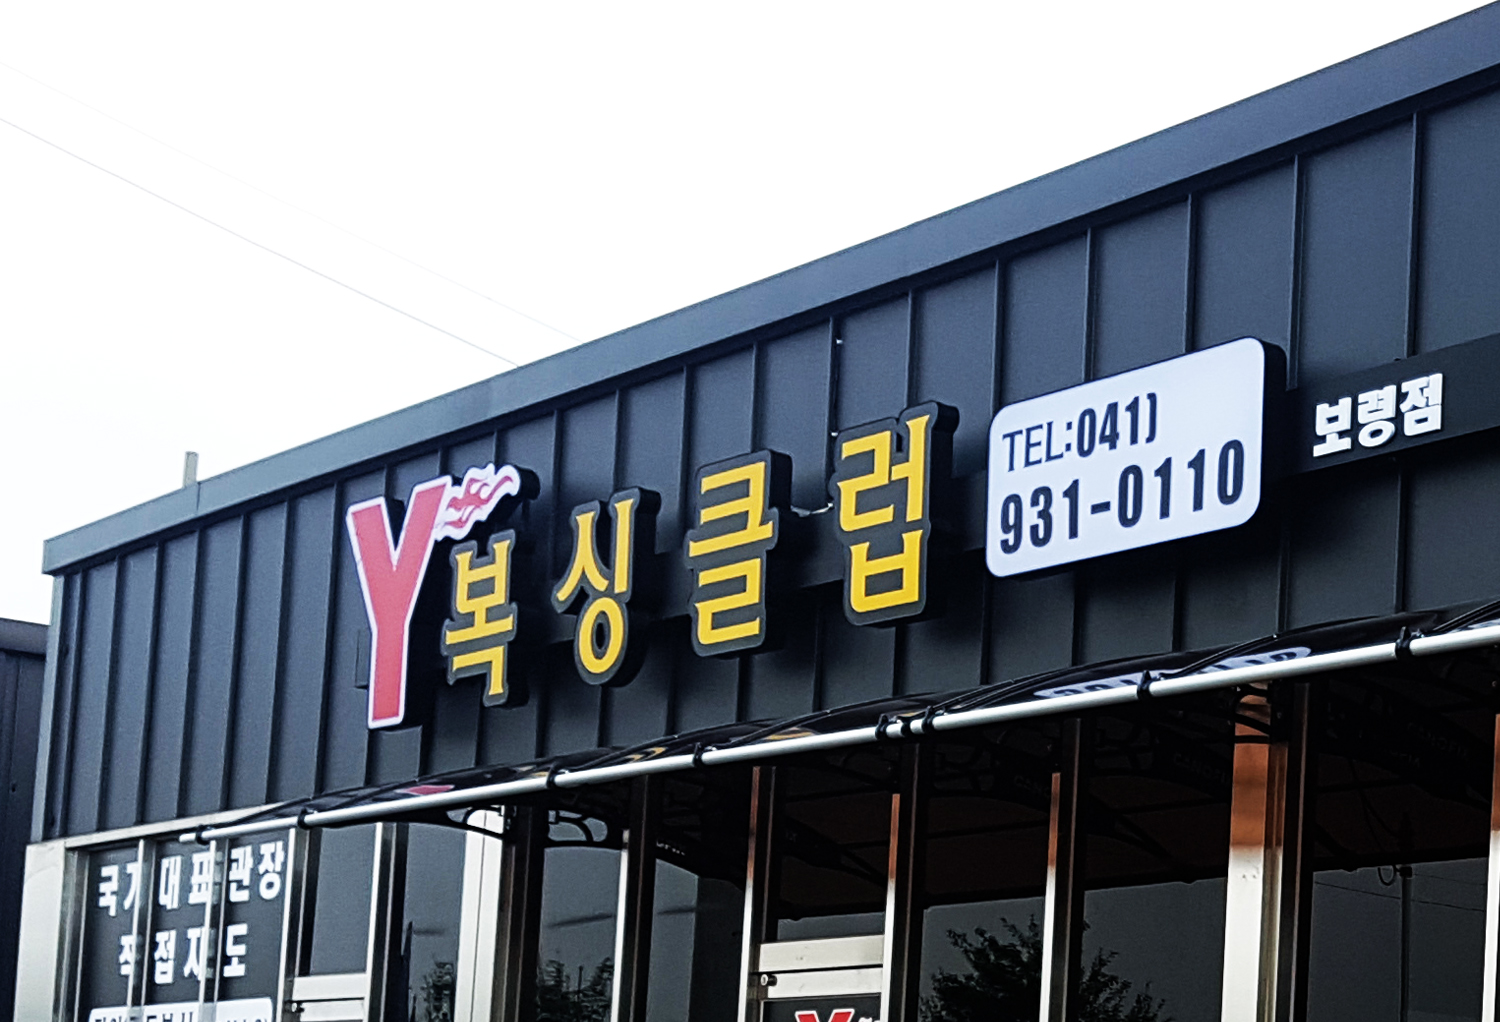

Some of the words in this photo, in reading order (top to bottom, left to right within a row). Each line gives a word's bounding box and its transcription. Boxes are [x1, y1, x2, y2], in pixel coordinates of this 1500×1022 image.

[1002, 393, 1158, 473] TEL:041)
[1313, 373, 1444, 457] 보령점
[1000, 439, 1244, 555] 931-0110
[446, 414, 931, 695] 복싱클럽
